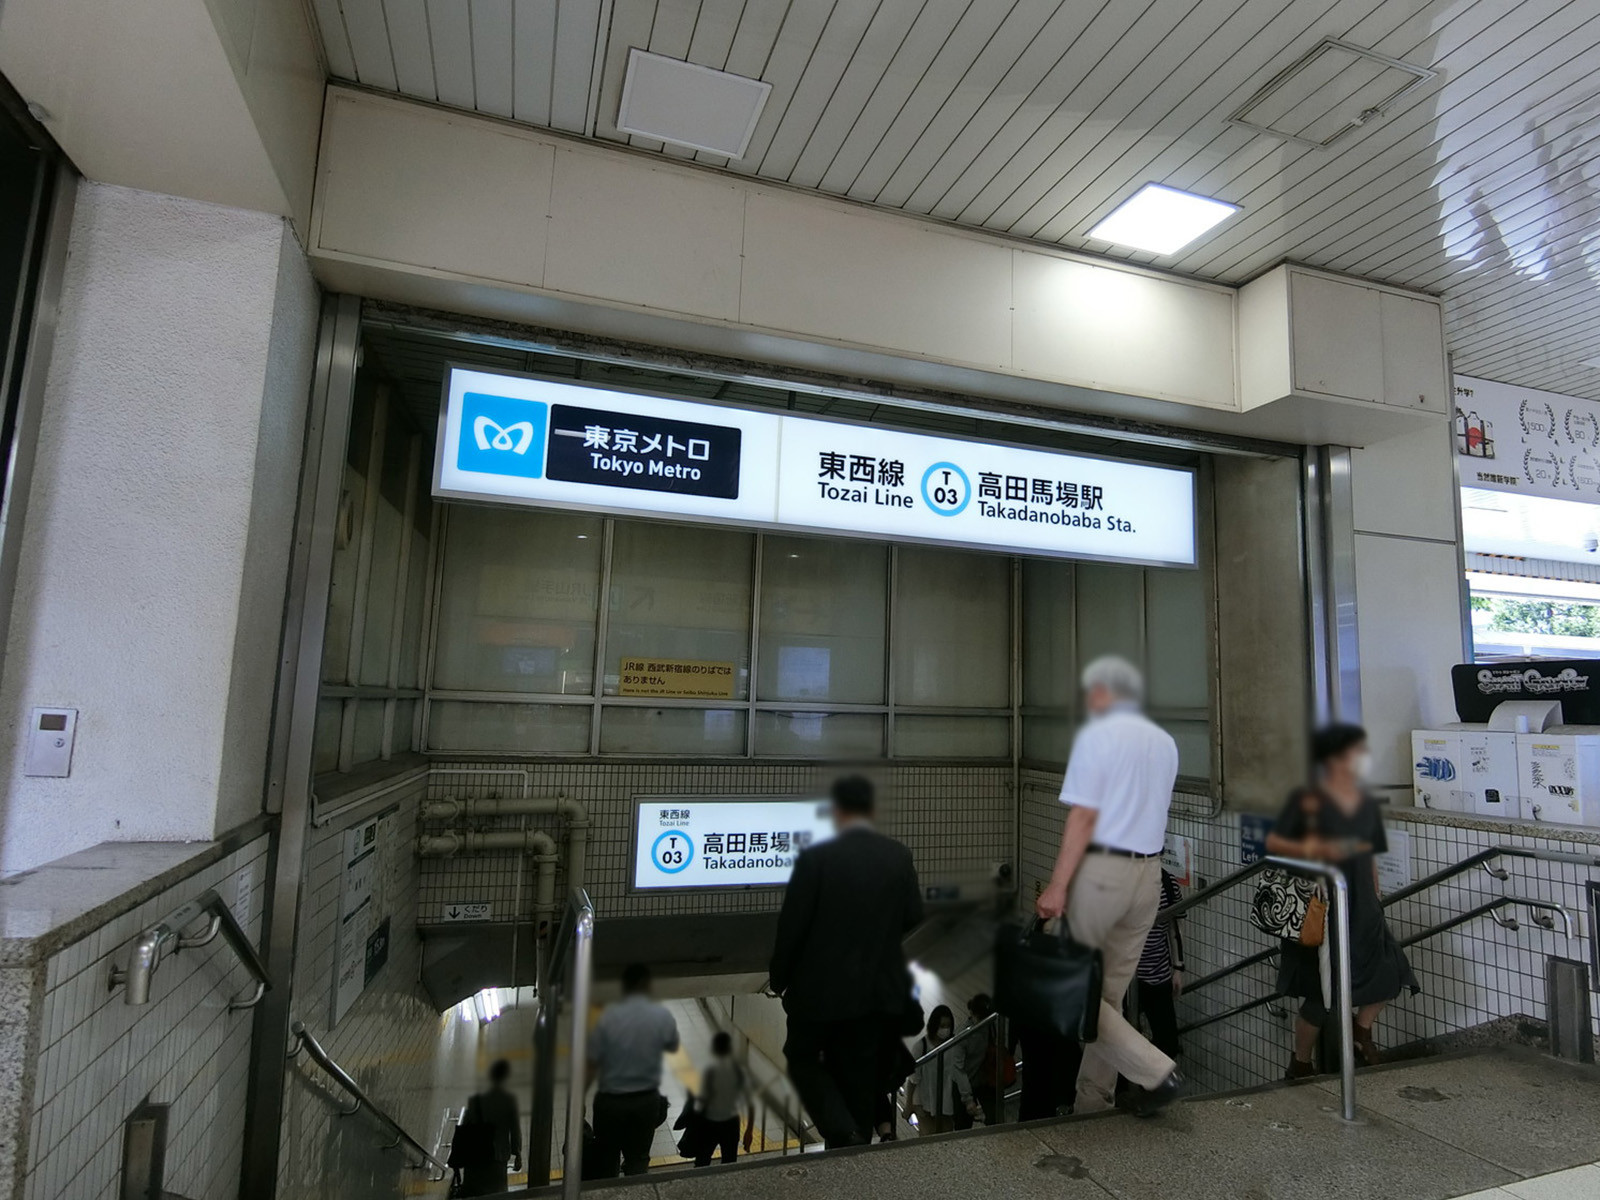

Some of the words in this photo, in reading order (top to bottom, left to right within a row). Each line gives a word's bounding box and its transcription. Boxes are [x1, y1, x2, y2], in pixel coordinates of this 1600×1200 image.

[583, 424, 710, 461] 東京メトロ
[590, 452, 644, 477] Tokyo
[649, 459, 701, 481] Metro
[818, 451, 905, 487] 東西線
[941, 471, 951, 486] T
[817, 481, 868, 504] Tozai
[875, 487, 914, 509] Line
[933, 487, 958, 505] 03
[977, 471, 1104, 511] 高田馬場駅
[977, 500, 1101, 530] Takadanobaba
[1107, 516, 1137, 534] Sta.
[624, 662, 644, 672] JR線
[647, 662, 732, 675] 西武新宿線のりばでは
[623, 675, 666, 685] ありません
[659, 809, 691, 819] 東西線
[669, 837, 677, 849] T
[662, 851, 682, 864] 03
[703, 854, 798, 870] Takadanoba
[1242, 851, 1258, 863] Left
[464, 905, 488, 913] くだり
